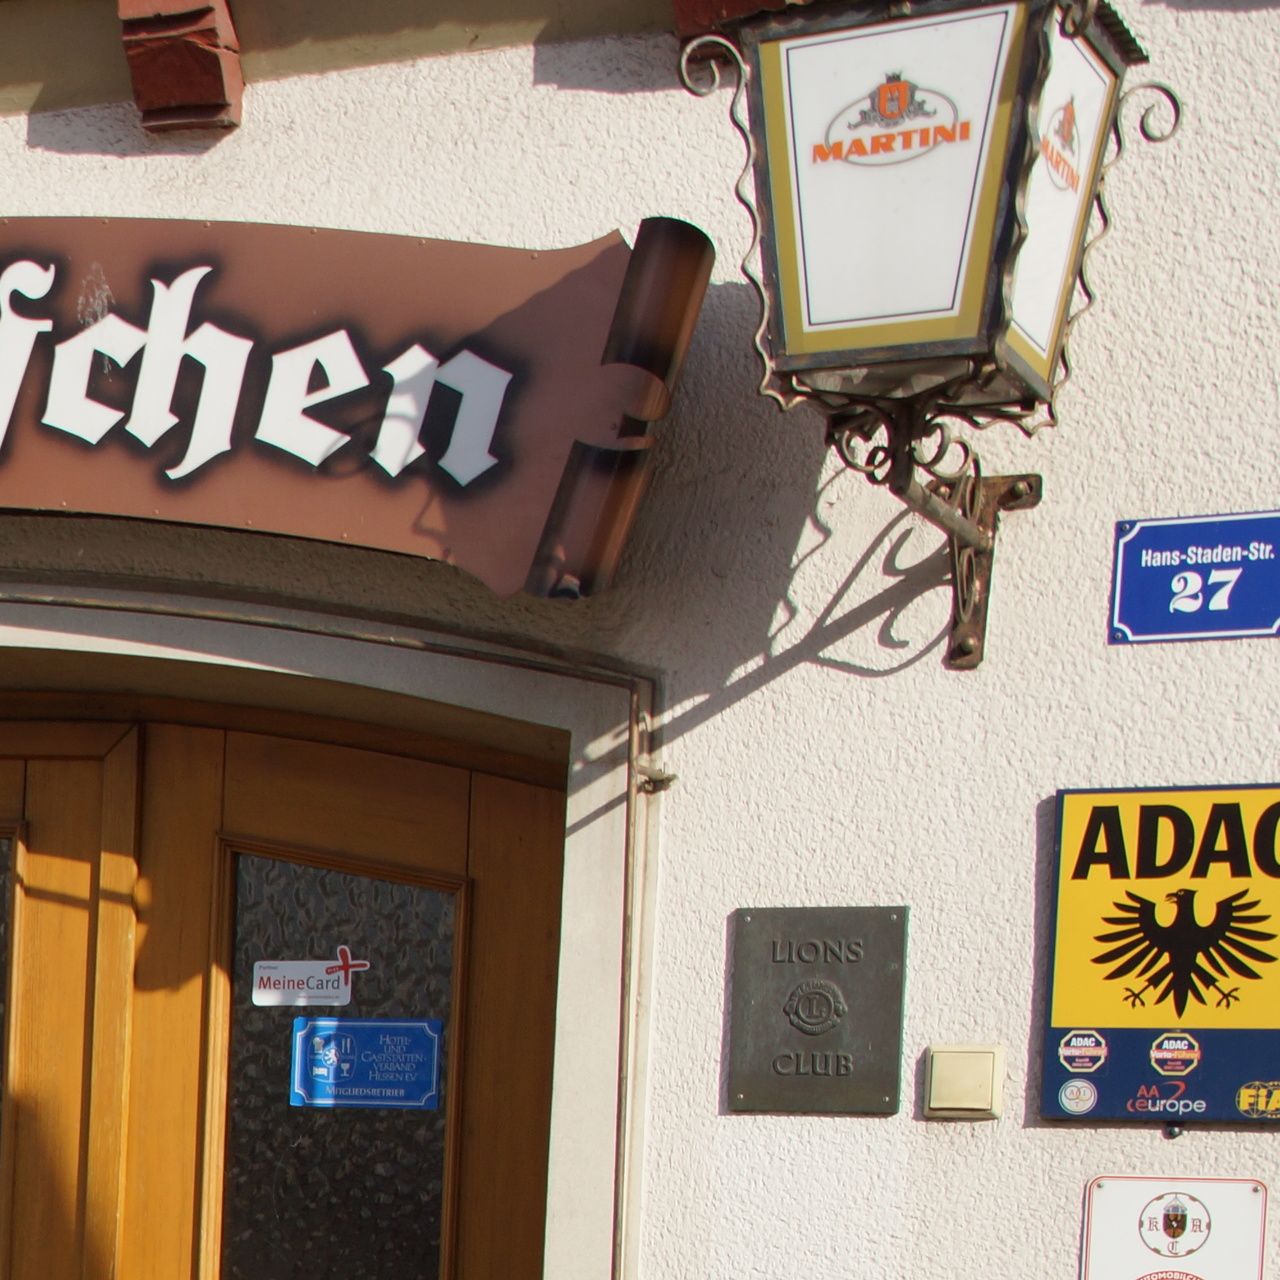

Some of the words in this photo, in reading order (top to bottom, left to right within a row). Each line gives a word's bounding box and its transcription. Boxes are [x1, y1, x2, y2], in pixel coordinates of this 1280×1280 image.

[812, 121, 971, 164] MARTINI
[1041, 135, 1080, 194] MARTINI
[1140, 541, 1276, 568] Hans-Staden-Str.
[1168, 567, 1244, 614] 27
[771, 938, 865, 965] LIONS
[258, 975, 341, 990] MeineCard
[1070, 1037, 1096, 1047] ADAC
[1161, 1039, 1189, 1049] ADAC
[772, 1052, 855, 1077] CLUB
